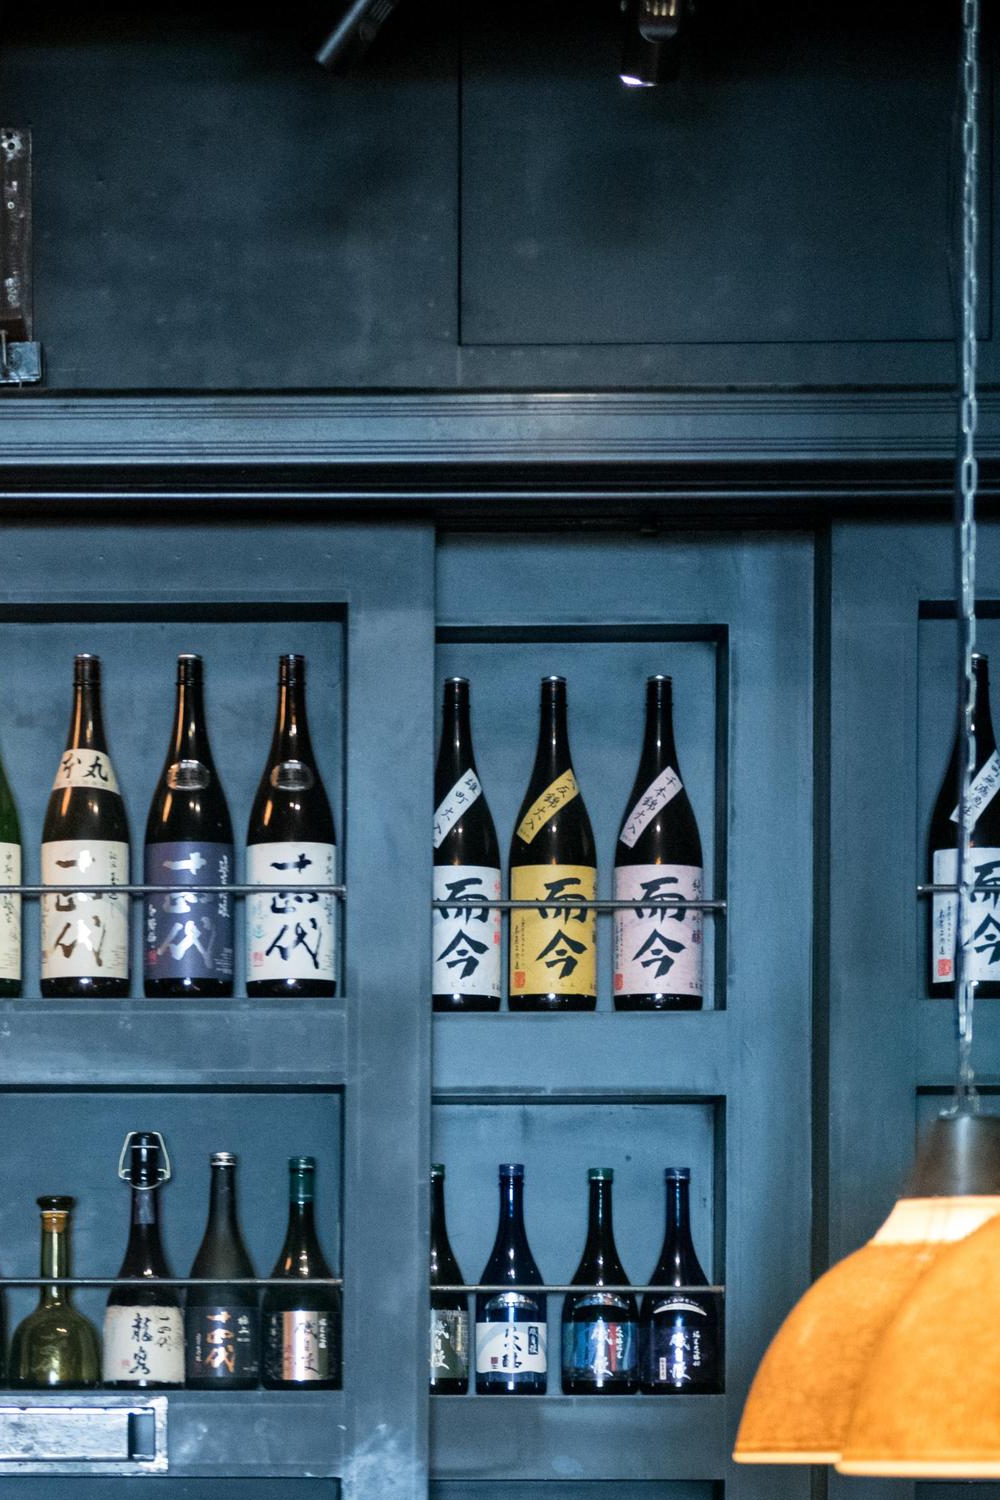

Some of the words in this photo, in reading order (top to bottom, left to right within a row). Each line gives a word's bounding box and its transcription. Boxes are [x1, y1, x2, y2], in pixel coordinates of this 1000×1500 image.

[435, 876, 491, 980] 而今
[535, 876, 589, 980] 而今
[631, 876, 688, 980] 而今
